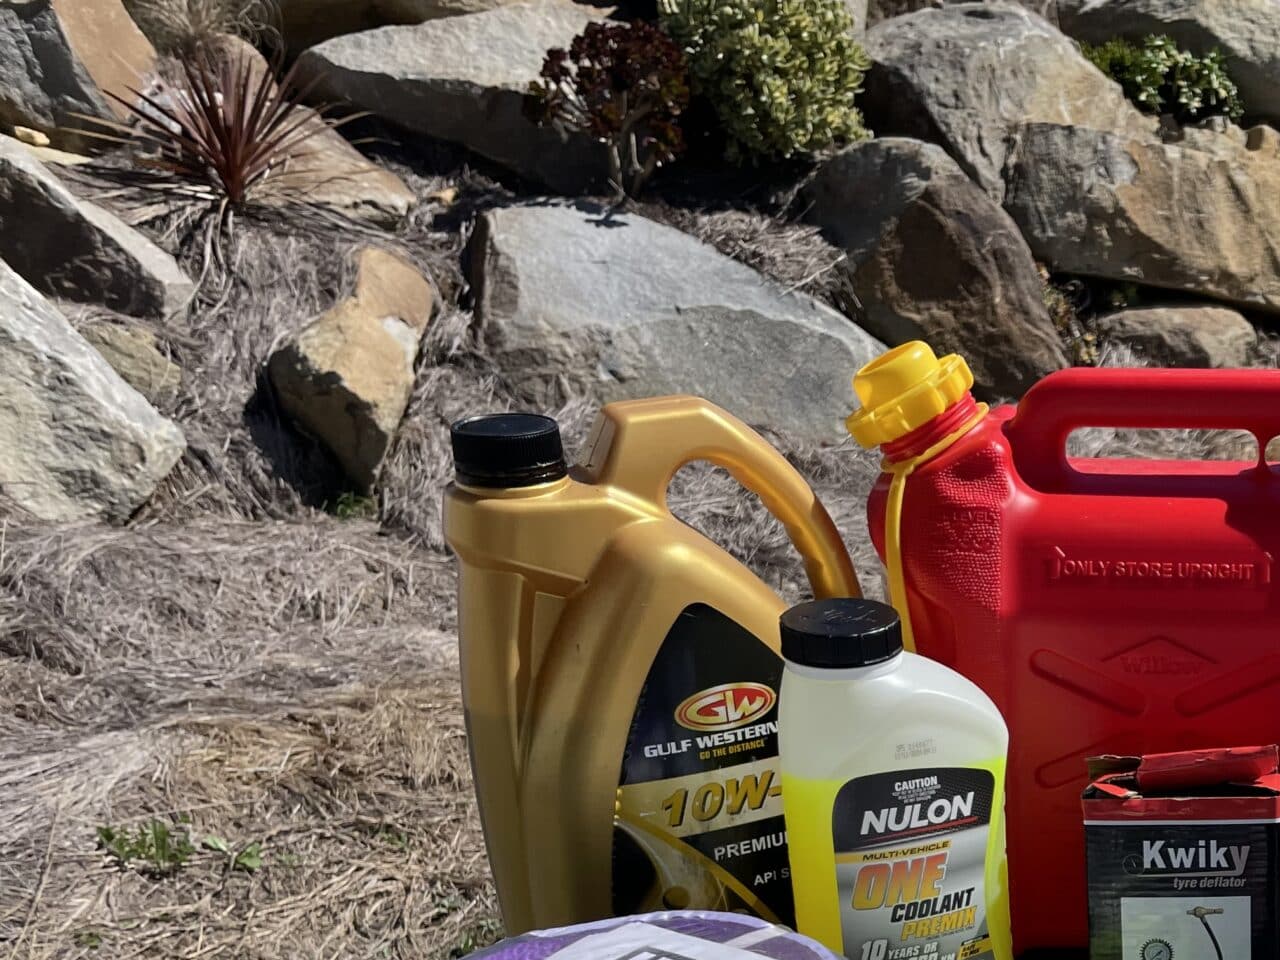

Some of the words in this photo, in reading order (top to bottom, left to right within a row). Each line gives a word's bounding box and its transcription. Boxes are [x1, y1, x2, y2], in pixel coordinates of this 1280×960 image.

[1063, 560, 1110, 577] ONLY
[1115, 561, 1173, 578] STORE
[1178, 562, 1255, 581] UPRIGHT
[687, 690, 765, 724] GW
[644, 738, 692, 758] GULF
[695, 720, 779, 749] WESTERN
[699, 751, 711, 760] GO
[713, 747, 727, 757] THE
[729, 740, 765, 754] DISTANCE
[662, 769, 782, 828] 10W-
[895, 776, 938, 792] CAUTION
[860, 791, 975, 835] NULON
[714, 832, 787, 861] PREMIU
[862, 840, 950, 862] MULTI-VEHICLE
[1142, 840, 1250, 876] Kwiky
[754, 870, 777, 886] API
[851, 852, 950, 911] ONE
[1173, 876, 1197, 890] tyre
[1200, 875, 1247, 889] deflator
[890, 887, 975, 923] COOLANT
[901, 905, 978, 941] PREMIX
[888, 945, 921, 959] YEARS
[924, 941, 938, 953] OR
